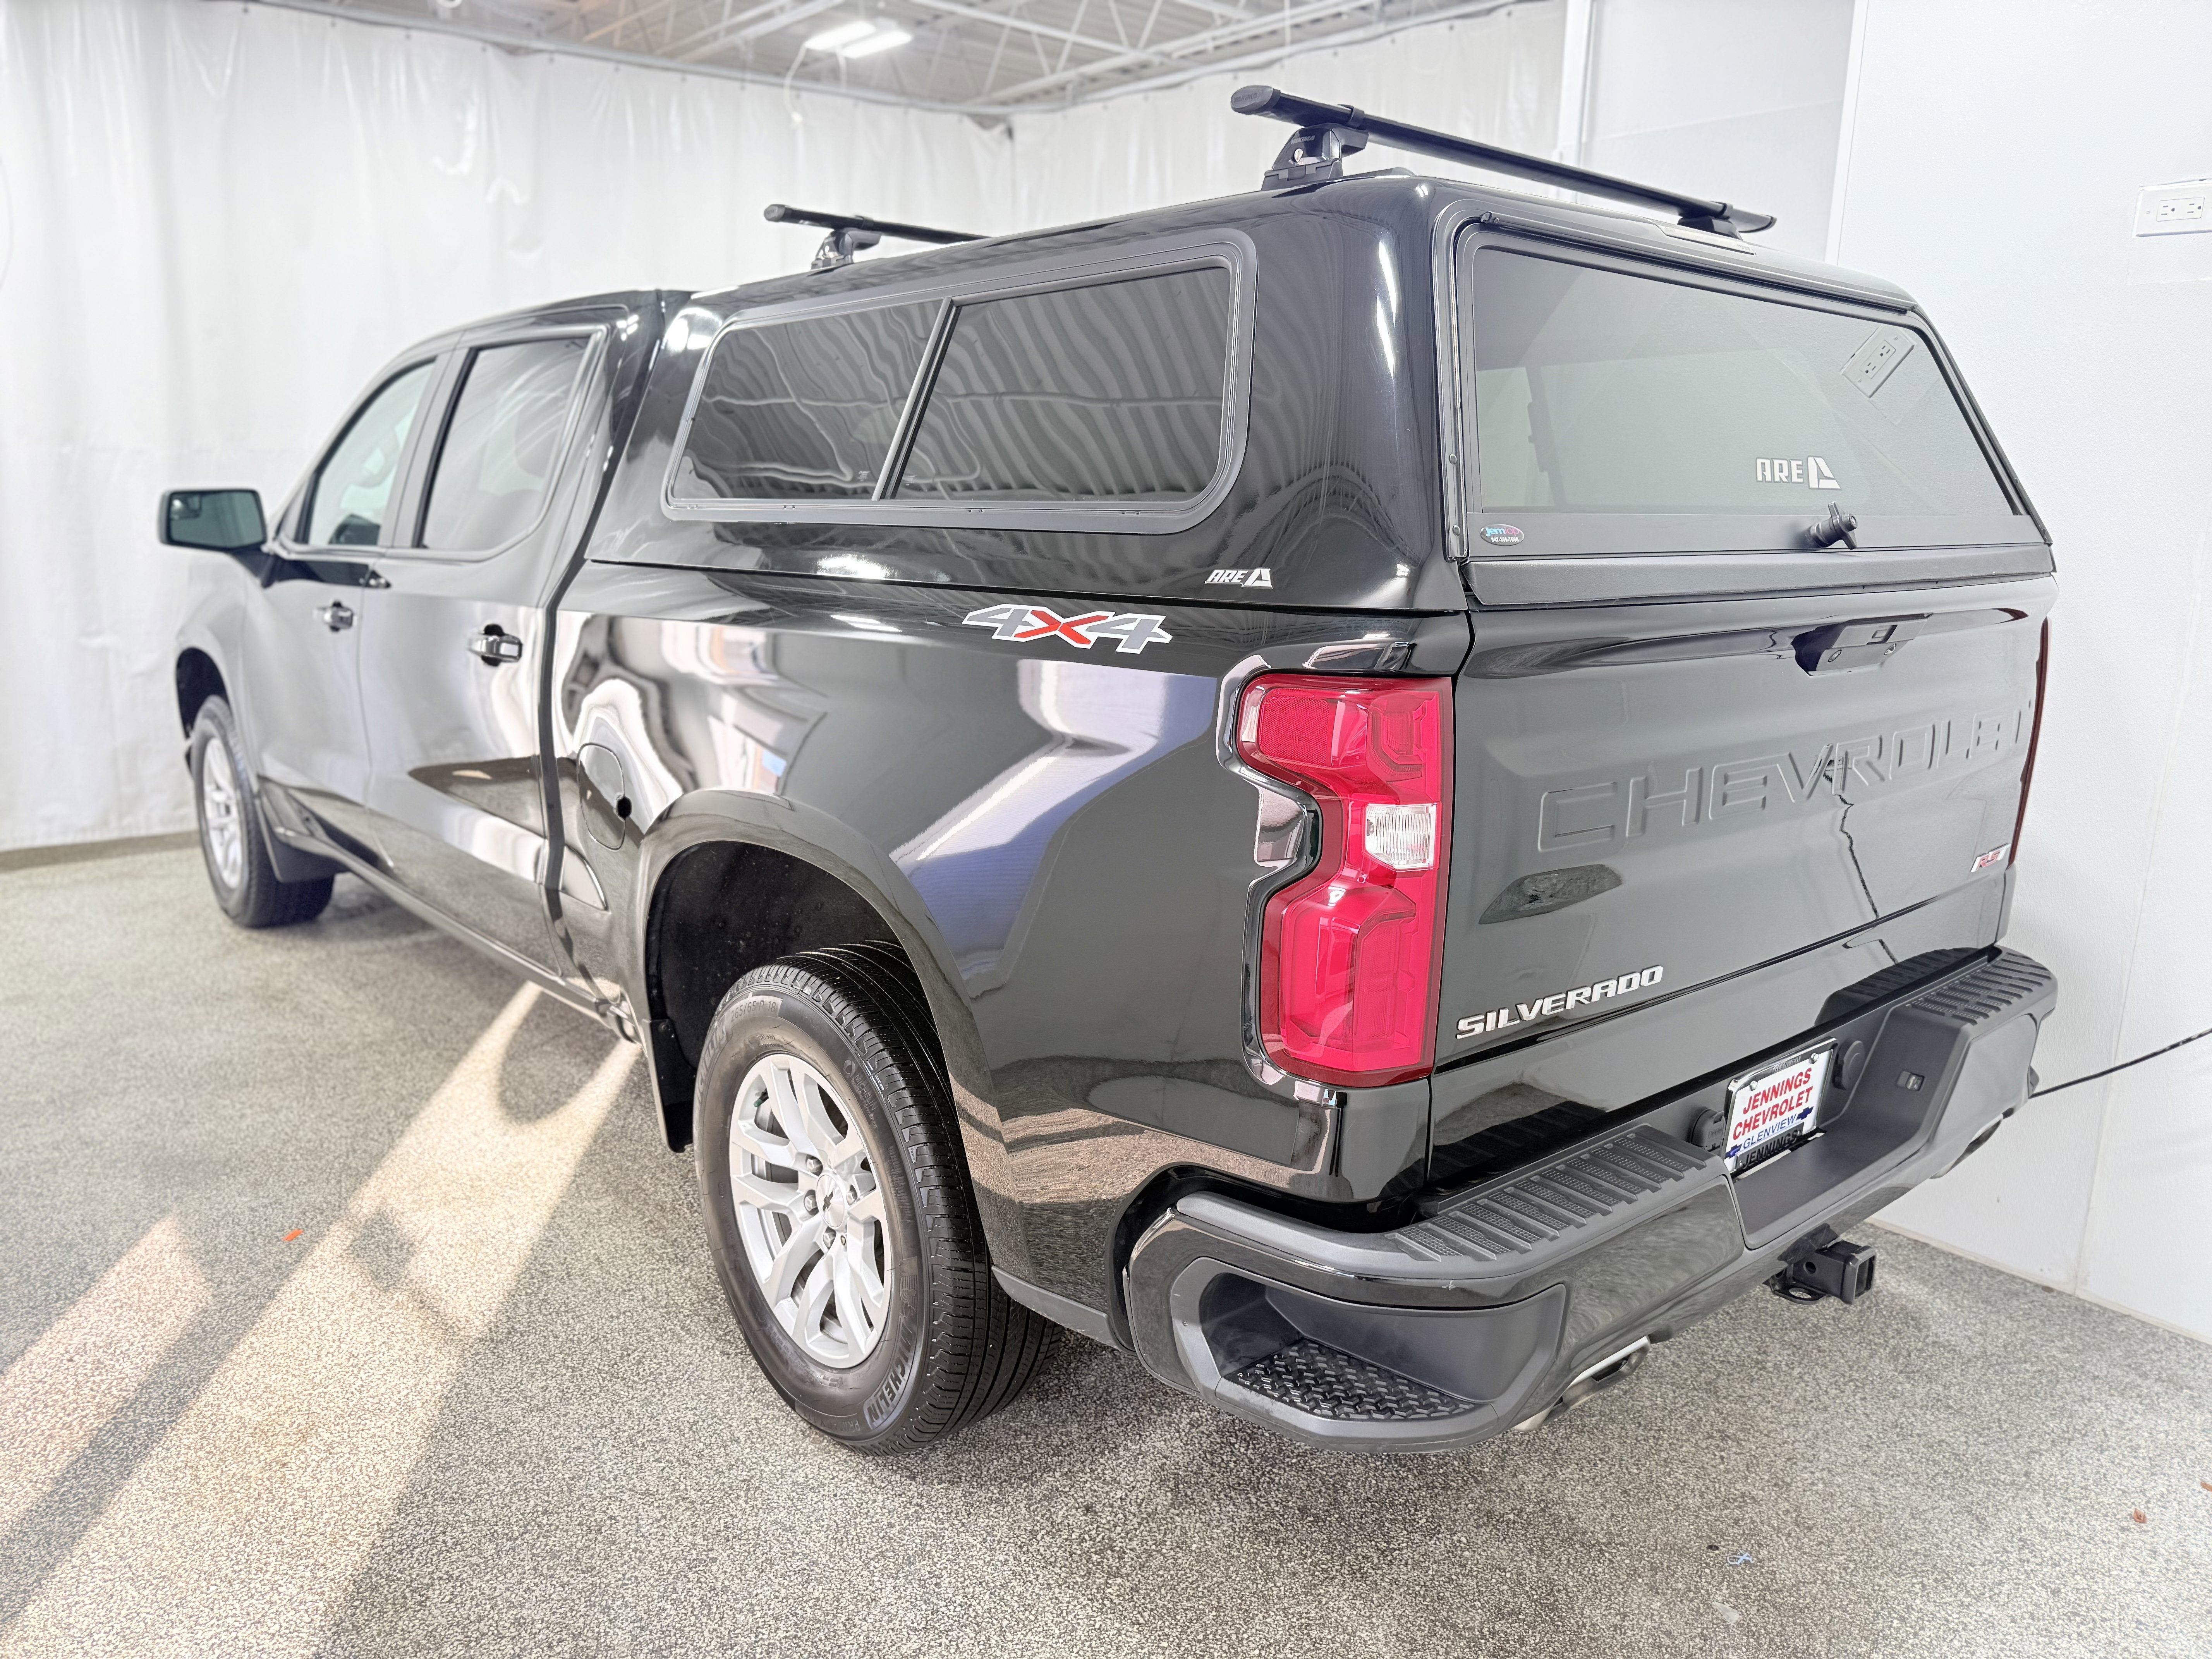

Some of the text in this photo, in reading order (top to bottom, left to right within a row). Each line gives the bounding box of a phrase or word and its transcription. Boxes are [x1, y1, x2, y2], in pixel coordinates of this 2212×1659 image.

[1456, 965, 1663, 1039] SILVERADO
[1733, 1086, 1813, 1140] CHEVROLET
[1743, 1067, 1812, 1115] JENNINGS
[1743, 1114, 1797, 1149] GLENVIEW
[1743, 1129, 1798, 1167] JENNINGS
